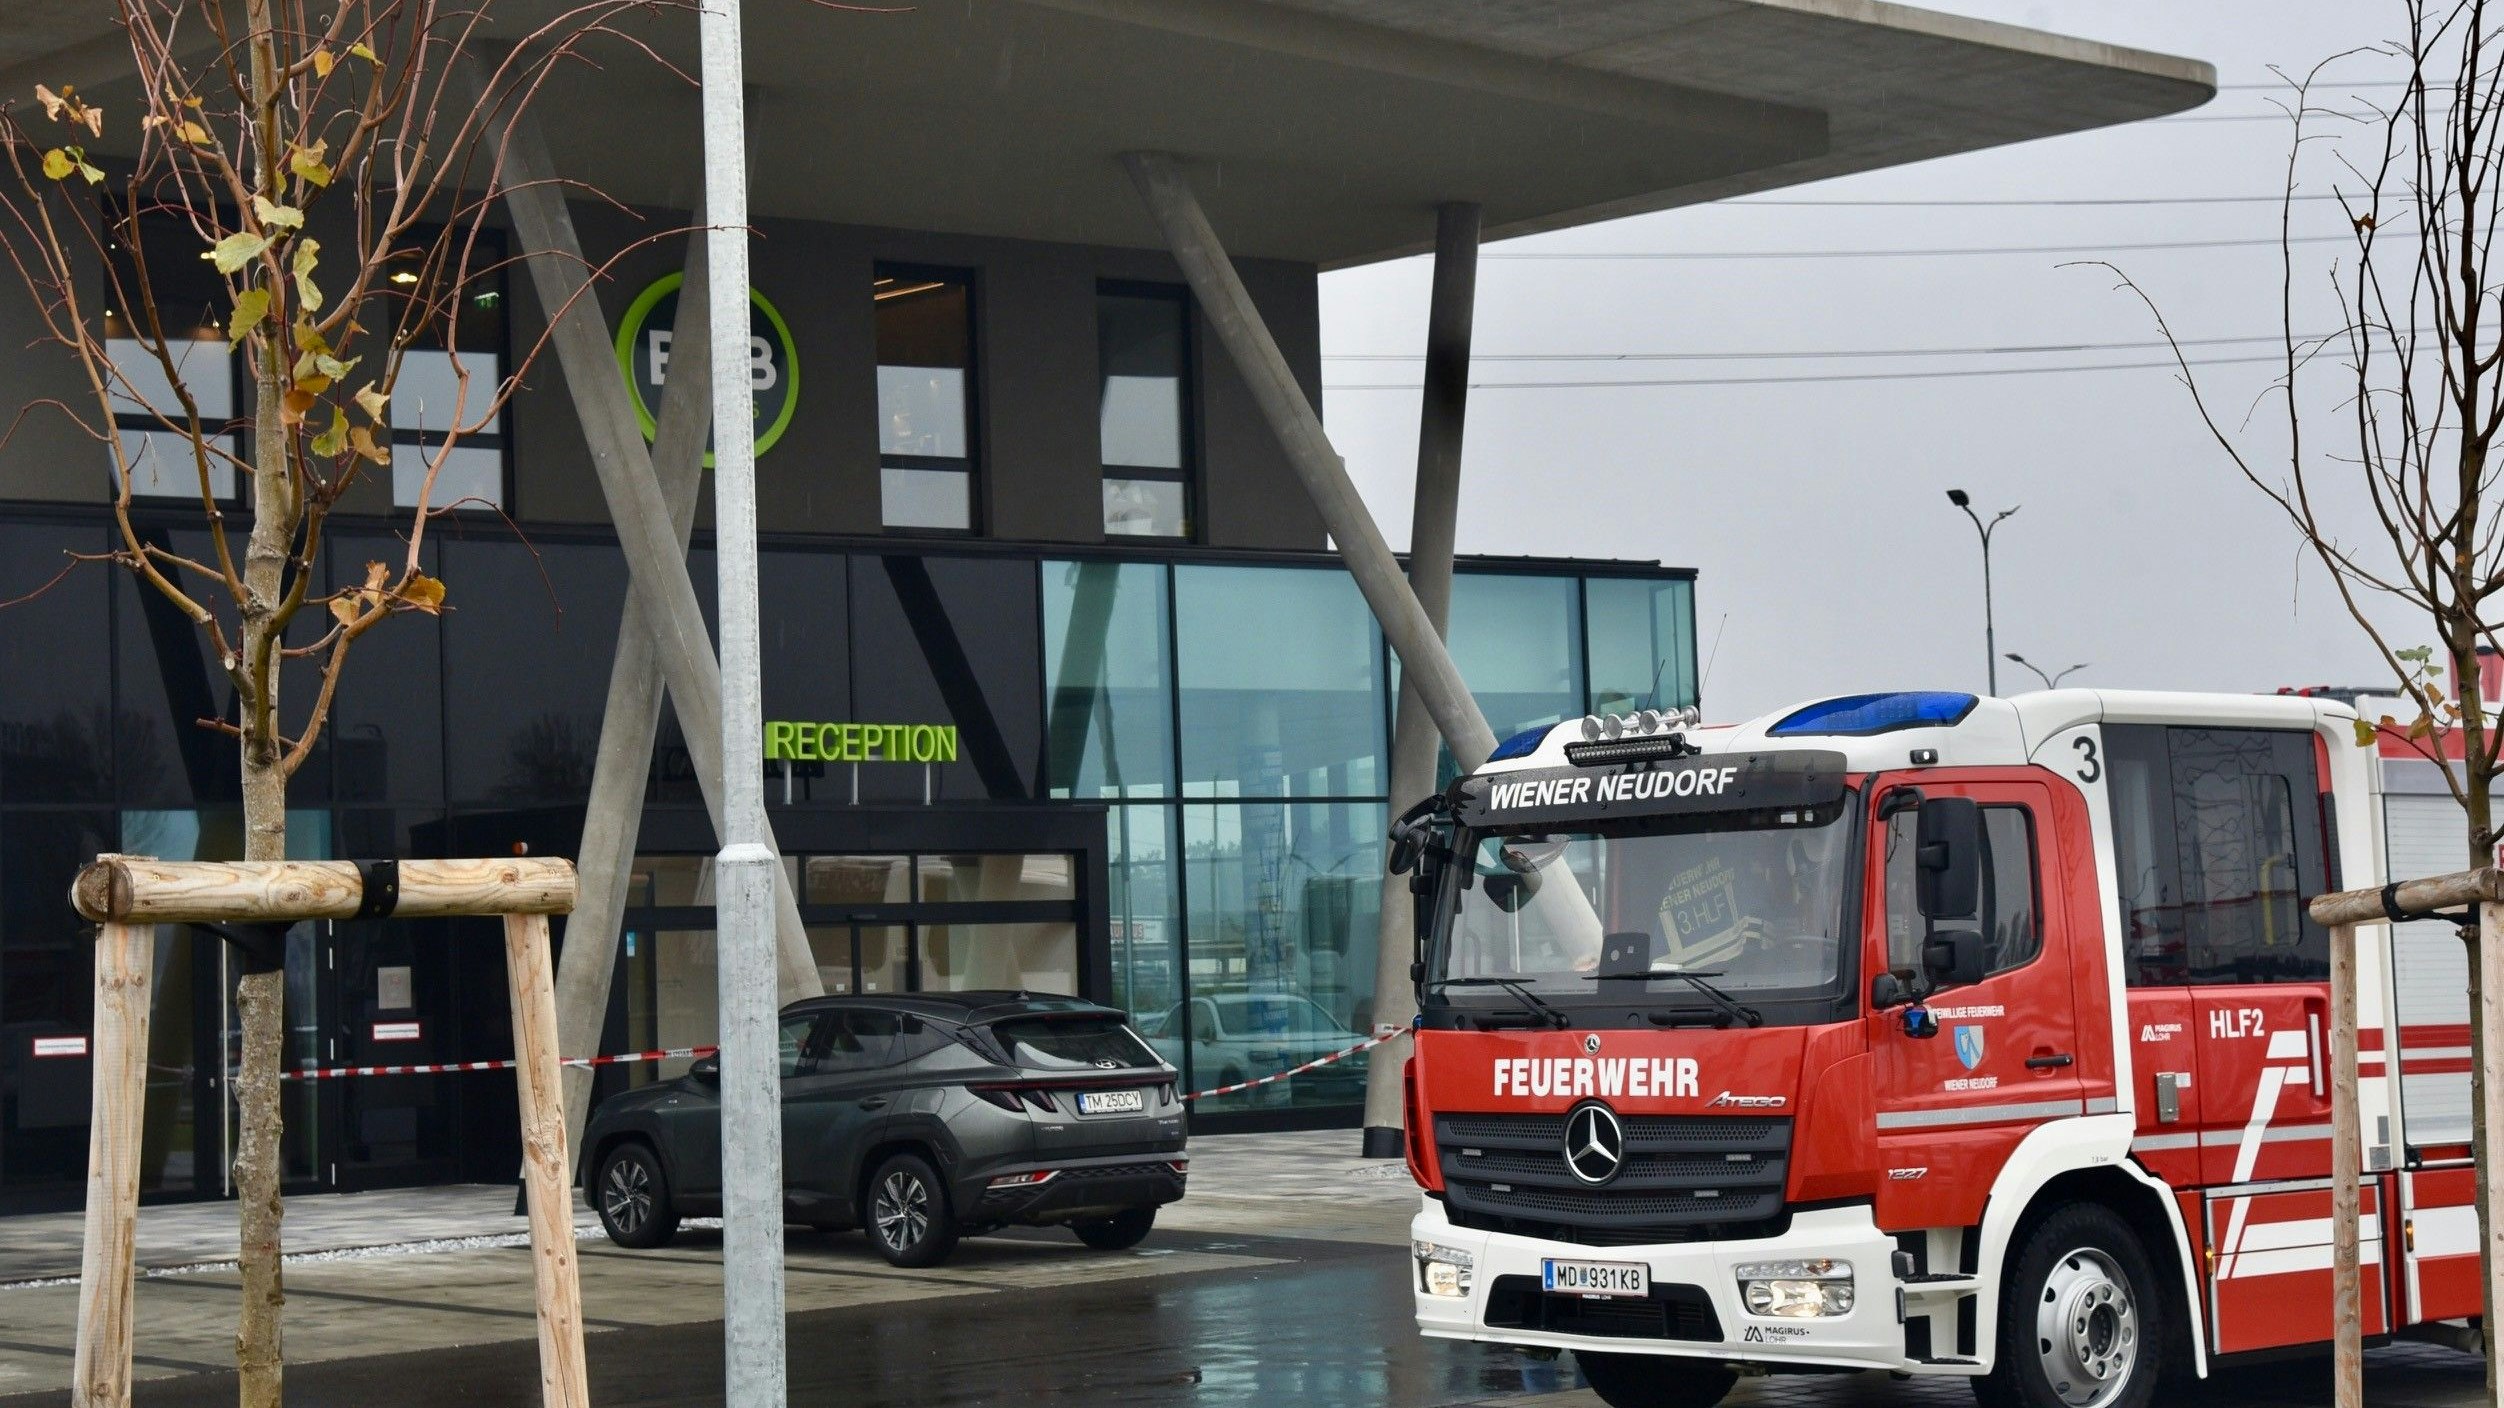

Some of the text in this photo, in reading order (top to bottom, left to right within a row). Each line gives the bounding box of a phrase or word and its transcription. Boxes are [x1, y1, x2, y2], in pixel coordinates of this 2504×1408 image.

[767, 721, 956, 762] RECEPTION
[2072, 736, 2101, 784] 3
[1490, 767, 1737, 810] WIENER NEUDORF
[2209, 1008, 2265, 1039] HLF2
[1494, 1057, 1699, 1097] FEUERWEHR
[1944, 1077, 1998, 1091] WIENER NEUDORF
[1085, 1094, 1103, 1110] TM
[1557, 1266, 1577, 1287] MD
[1765, 1326, 1806, 1336] MAGIRUS
